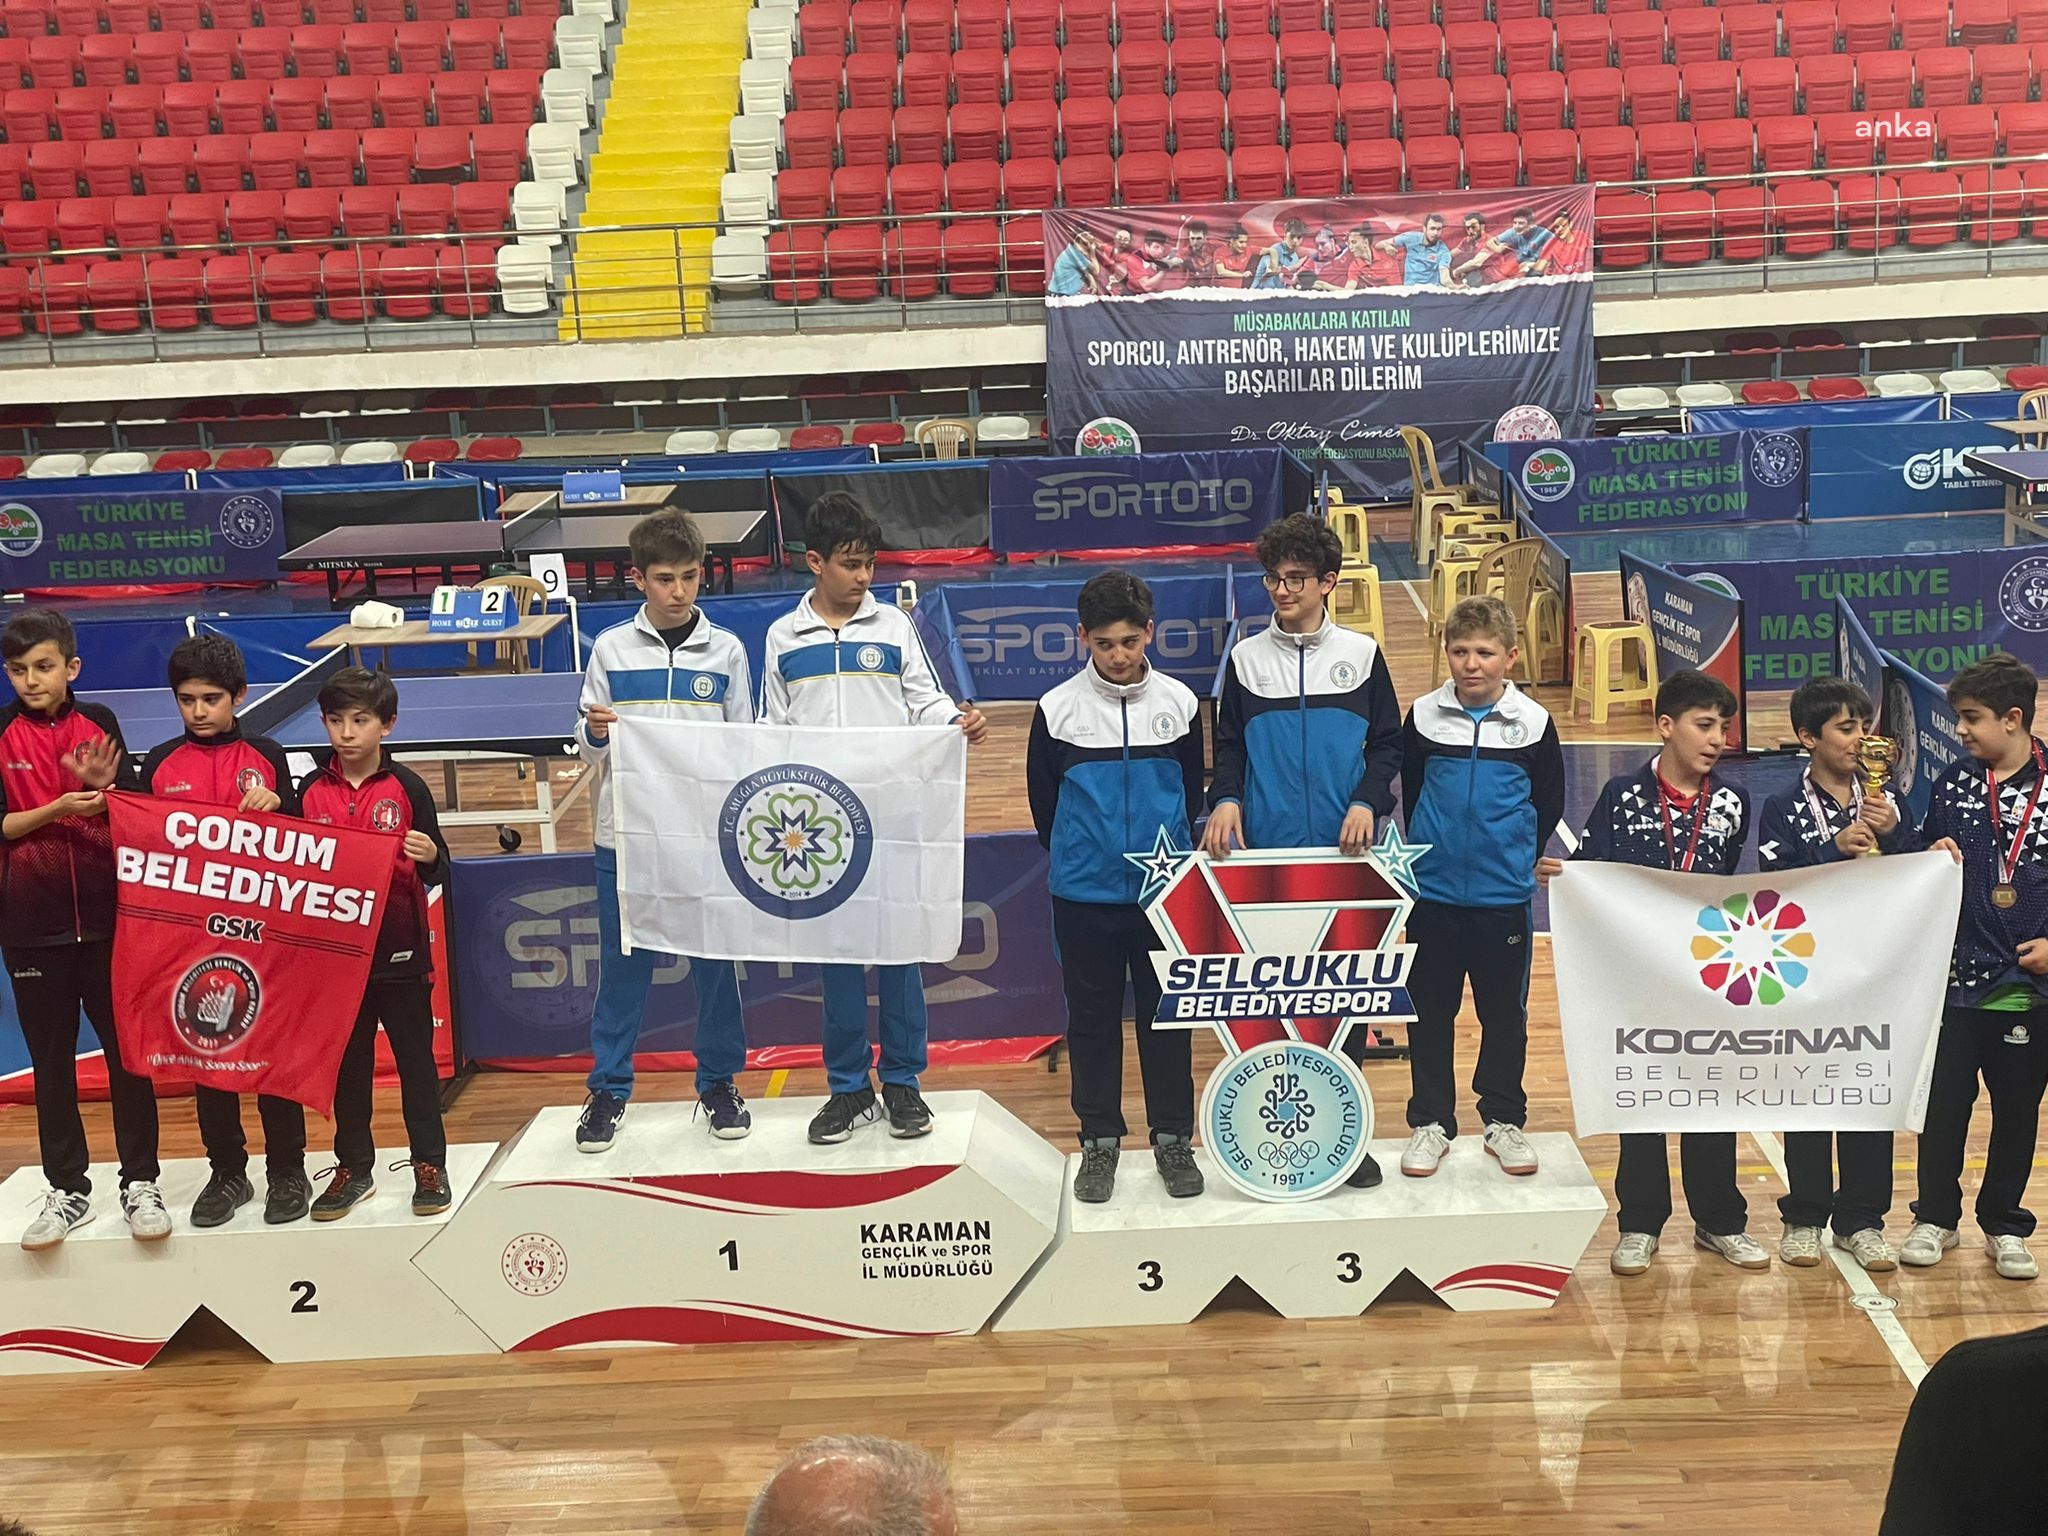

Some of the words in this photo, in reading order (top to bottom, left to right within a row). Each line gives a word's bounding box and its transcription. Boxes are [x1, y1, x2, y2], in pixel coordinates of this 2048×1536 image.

[1234, 309, 1348, 332] MÜSABAKALARA
[1352, 309, 1410, 329] KATILAN
[1088, 340, 1171, 369] SPORCU,
[1177, 334, 1289, 366] ANTRENÖR,
[1295, 335, 1365, 363] HAKEM
[1371, 334, 1396, 360] VE
[1402, 323, 1561, 359] KULÜPLERİMİZE
[1225, 368, 1335, 398] BAŞARILAR
[1341, 361, 1422, 391] DİLERİM
[1267, 421, 1334, 449] Oktay
[1612, 436, 1721, 465] TÜRKİYE
[1588, 474, 1657, 496] MASA
[1665, 459, 1744, 488] TENİSİ
[1943, 481, 1969, 489] TABLE
[77, 499, 186, 523] TÜRKİYE
[1032, 478, 1253, 521] SPORTOTO
[1578, 490, 1748, 523] FEDERASYONU
[57, 532, 124, 552] MASA
[132, 525, 212, 550] TENİSİ
[49, 556, 225, 580] FEDERASYONU
[318, 560, 359, 569] MITSUKA
[543, 569, 558, 592] 9
[1795, 564, 1949, 600] TÜRKİYE
[440, 591, 448, 613] 1
[486, 591, 498, 613] 2
[1665, 592, 1693, 615] KARAMAN
[432, 619, 451, 627] HOME
[1685, 625, 1701, 643] SPOR
[1760, 612, 1834, 642] MAS
[1869, 599, 1983, 637] TENİSİ
[1920, 730, 1948, 765] GENÇLİK
[731, 781, 760, 814] MUĞLA
[829, 784, 868, 835] BELEDİYESİ
[165, 811, 337, 871] ÇORUM
[206, 912, 264, 944] GSK
[1167, 952, 1404, 995] SELÇUKLU
[1234, 1050, 1349, 1098] BELEDİYESPOR
[1615, 1060, 1891, 1081] BELEDİYESİ
[1616, 1089, 1719, 1108] SPOR
[1736, 1083, 1891, 1106] KULÜBÜ
[1219, 1087, 1253, 1171] SELÇUKLU
[1327, 1101, 1356, 1168] KULÜBÜ
[1272, 1172, 1305, 1186] 1997
[861, 1221, 991, 1244] KARAMAN
[718, 1240, 740, 1272] 1
[862, 1244, 927, 1261] GENÇLİK
[932, 1248, 947, 1257] ve
[952, 1244, 991, 1256] SPOR
[863, 1263, 878, 1279] İL
[884, 1260, 993, 1279] MÜDÜRLÜĞÜ
[1137, 1261, 1164, 1292] 3
[1336, 1252, 1363, 1284] 3
[289, 1281, 320, 1314] 2
